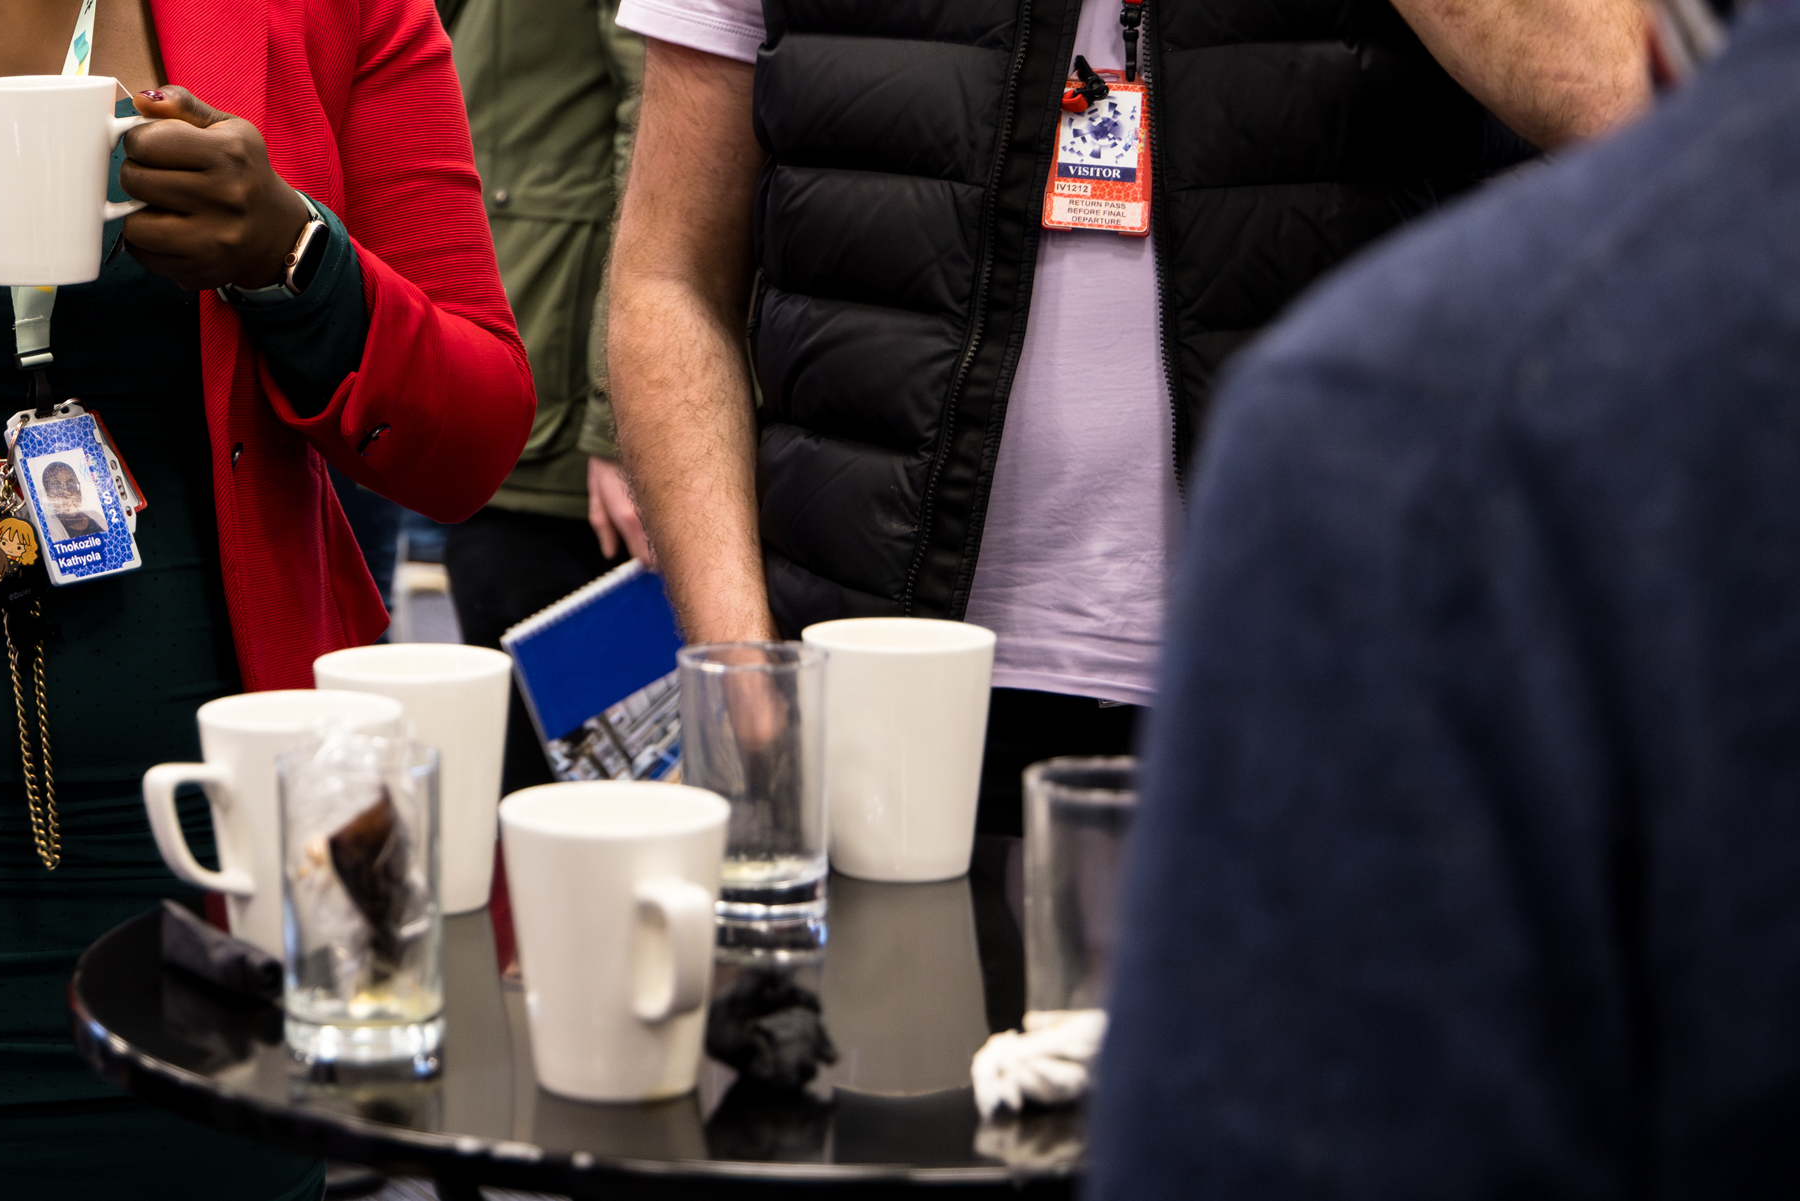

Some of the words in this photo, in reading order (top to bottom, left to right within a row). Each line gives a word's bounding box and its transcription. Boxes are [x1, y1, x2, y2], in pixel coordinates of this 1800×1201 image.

[1068, 166, 1121, 179] VISITOR
[1056, 183, 1089, 193] IV1212
[1069, 199, 1102, 207] RETURN
[1067, 207, 1101, 215] BEFORE
[1071, 216, 1121, 225] DEPARTURE
[102, 491, 113, 505] S
[109, 508, 119, 523] 2
[53, 536, 102, 555] Thokozile
[58, 551, 102, 568] Kathyola
